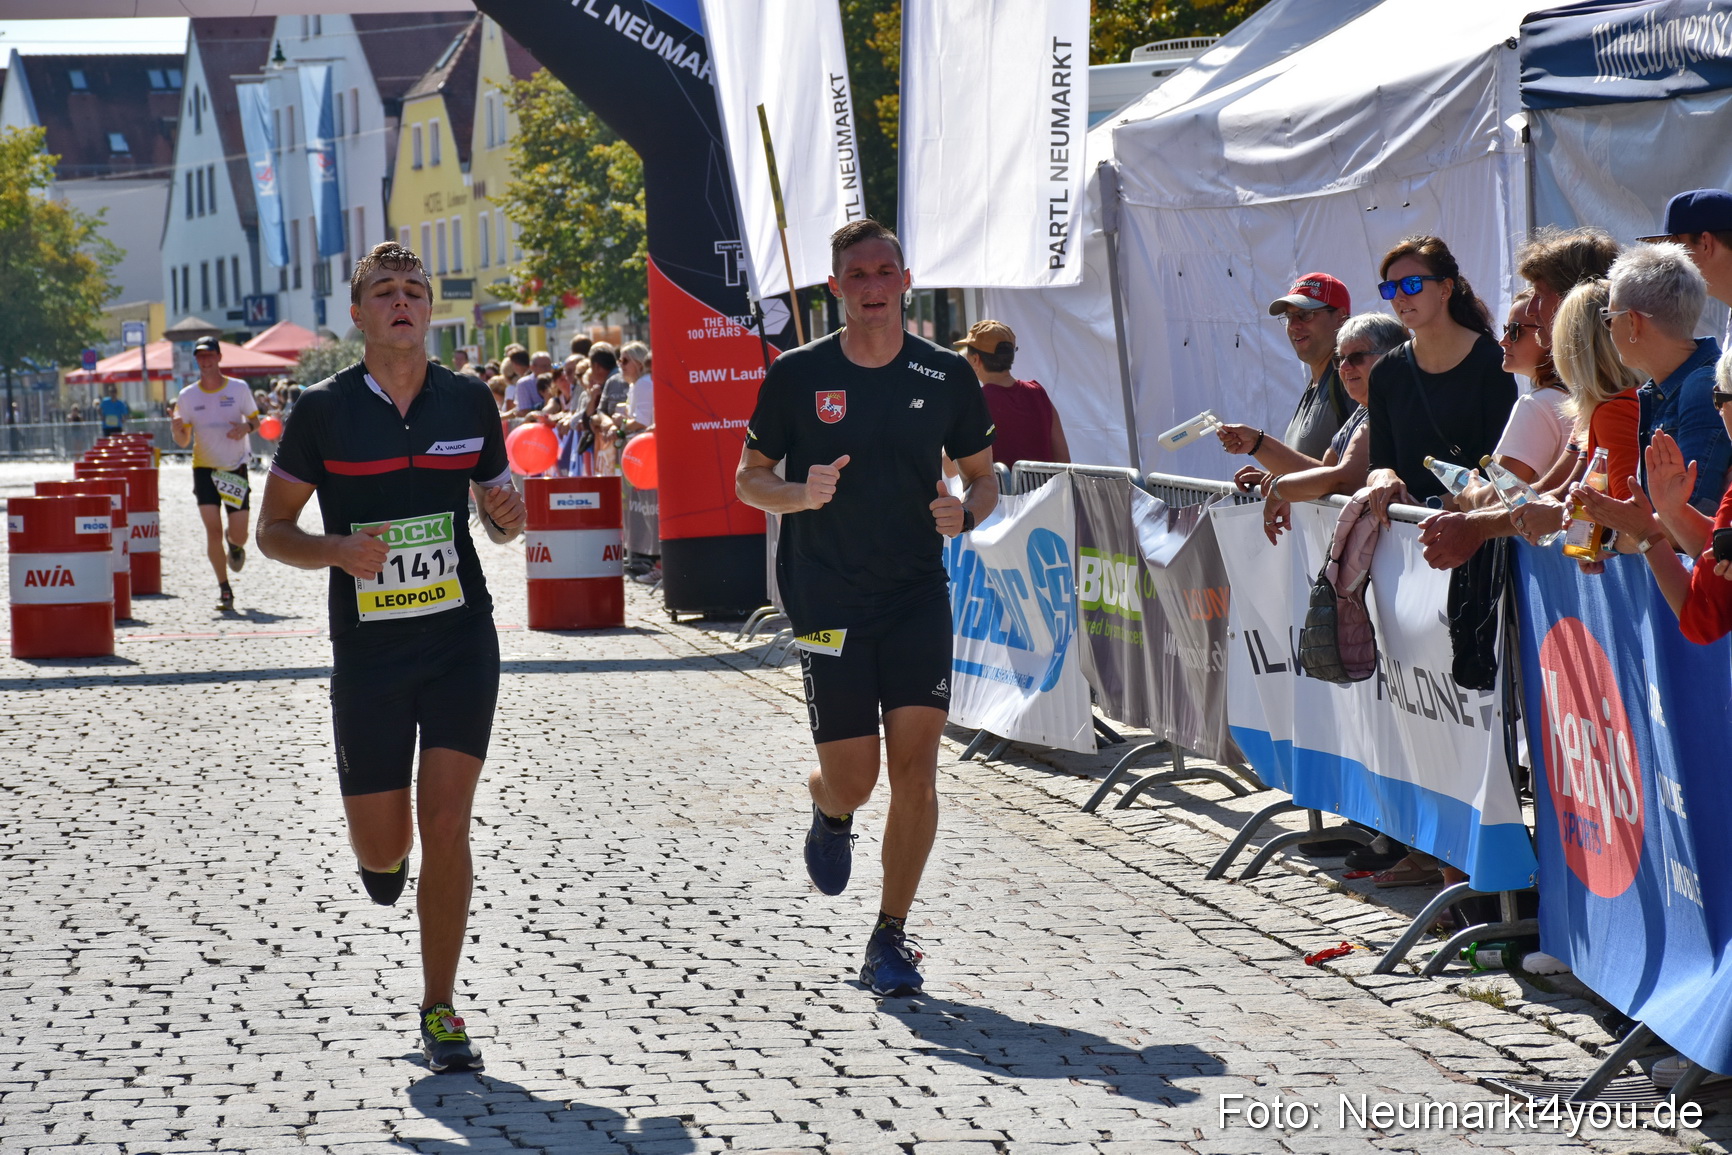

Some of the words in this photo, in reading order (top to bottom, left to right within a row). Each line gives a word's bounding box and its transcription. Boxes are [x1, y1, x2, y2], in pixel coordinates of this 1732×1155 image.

[1050, 36, 1072, 181] NEUMARKT
[830, 73, 858, 190] NEUMARKT
[845, 194, 861, 222] TL
[1049, 189, 1068, 270] PARTL
[687, 329, 704, 340] 100
[706, 326, 741, 338] YEARS
[703, 317, 724, 328] THE
[726, 315, 752, 326] NEXT
[689, 368, 727, 384] BMW
[907, 361, 946, 381] MATZE
[214, 480, 242, 498] 1228
[380, 517, 447, 546] OCK
[527, 542, 552, 562] VIA
[375, 587, 446, 608] LEOPOLD
[1541, 667, 1639, 845] Hervis
[1562, 811, 1602, 856] SPORTS
[1670, 857, 1703, 909] MOBILE
